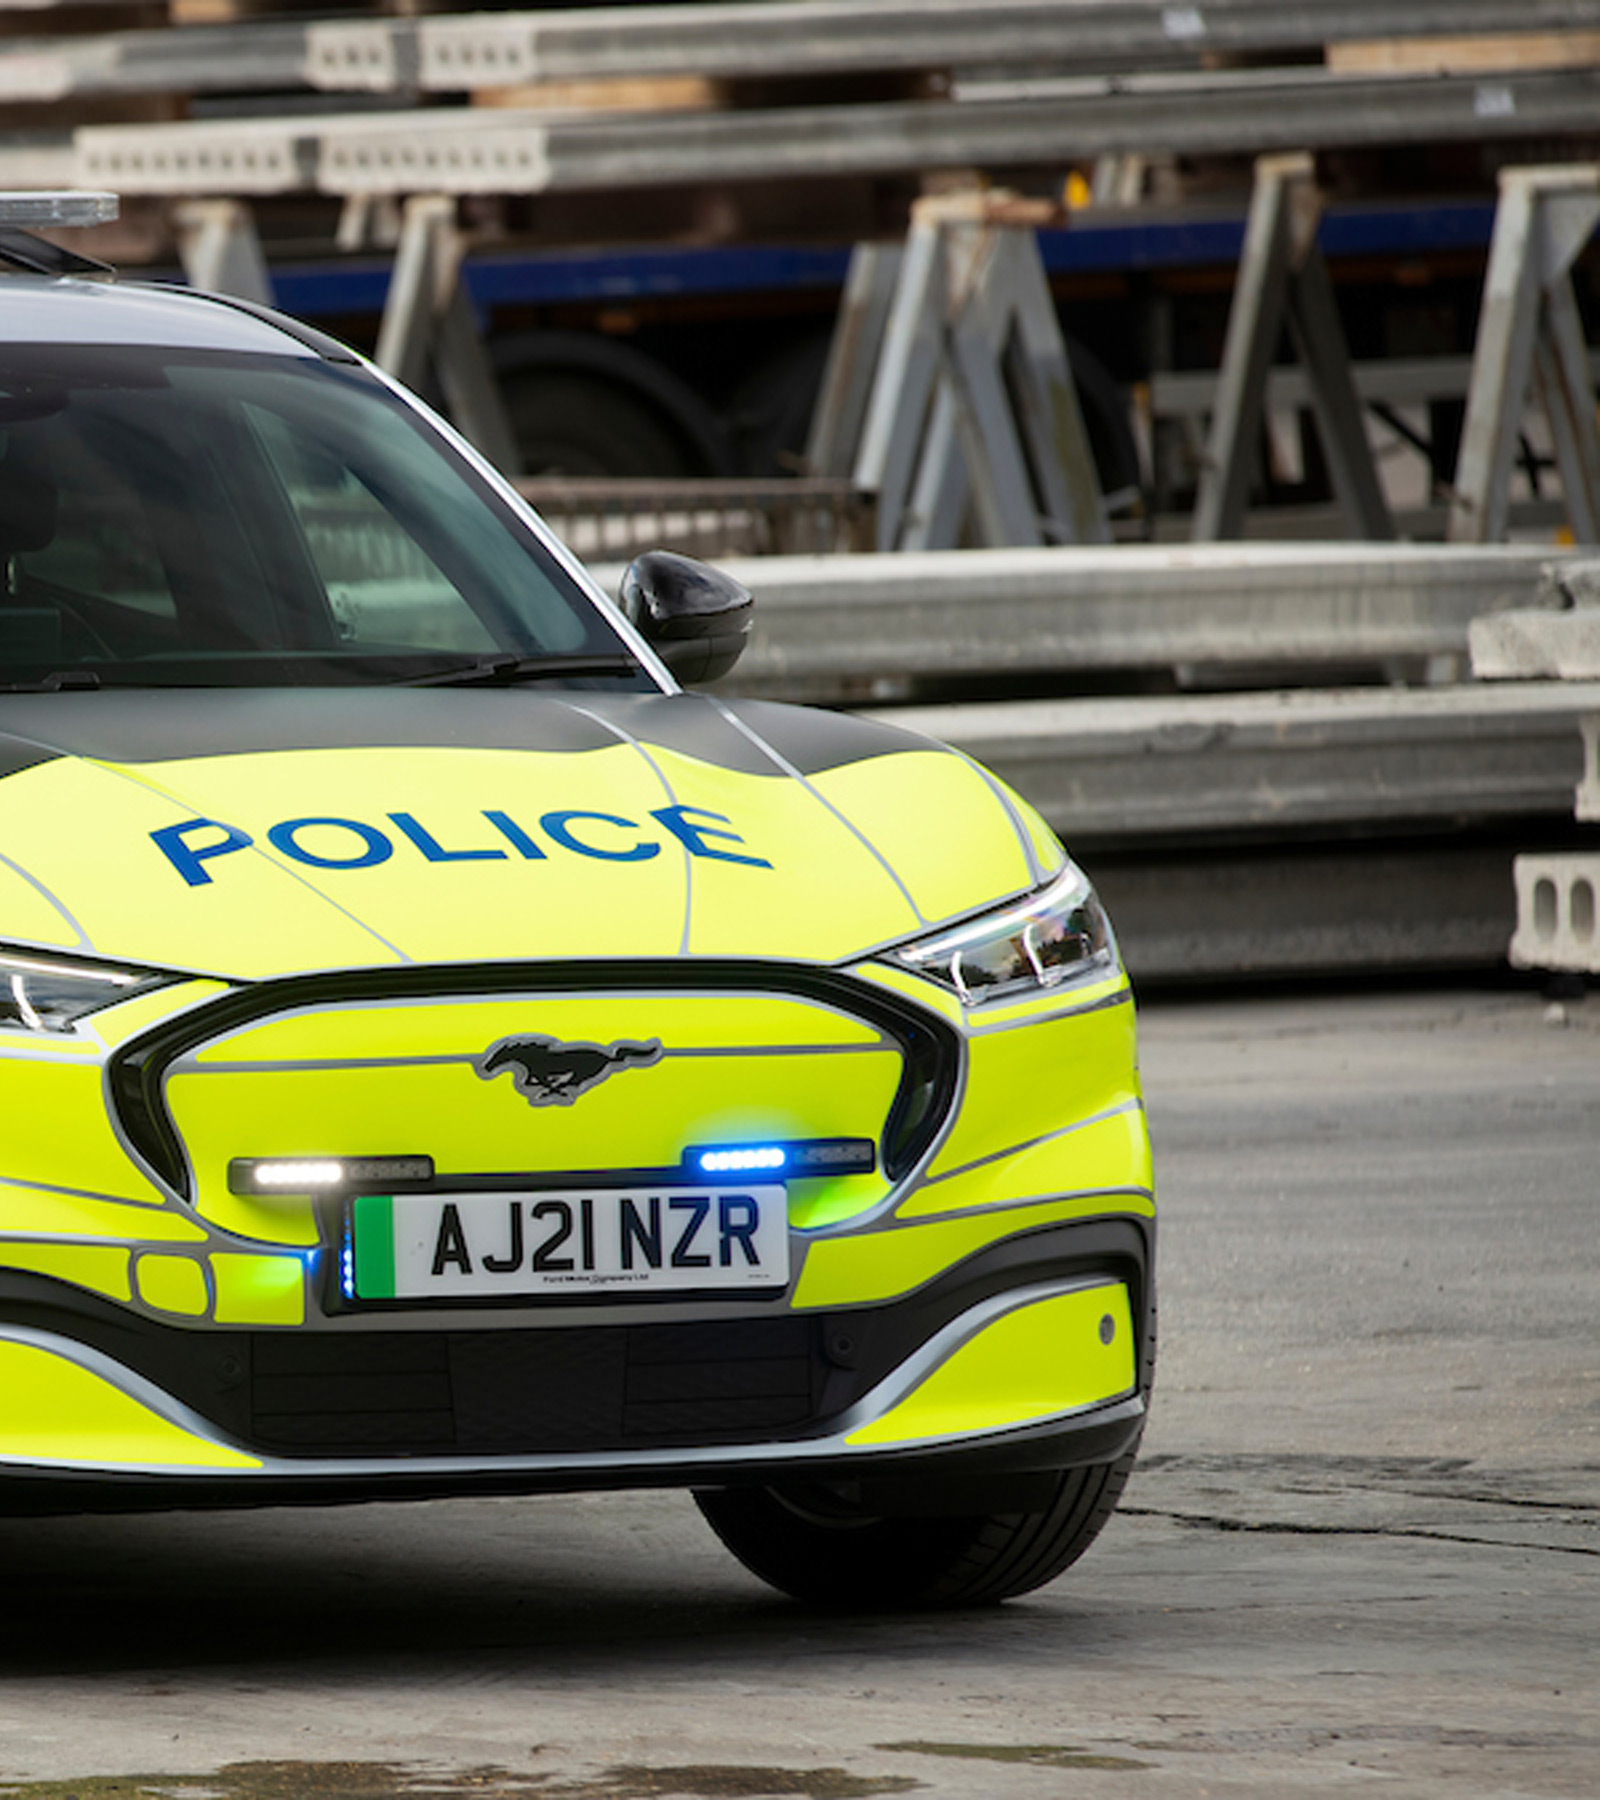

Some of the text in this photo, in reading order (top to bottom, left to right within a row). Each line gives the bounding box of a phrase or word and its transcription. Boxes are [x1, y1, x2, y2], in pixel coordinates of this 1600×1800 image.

[148, 803, 775, 887] POLICE
[431, 1195, 760, 1274] AJ21 NZR
